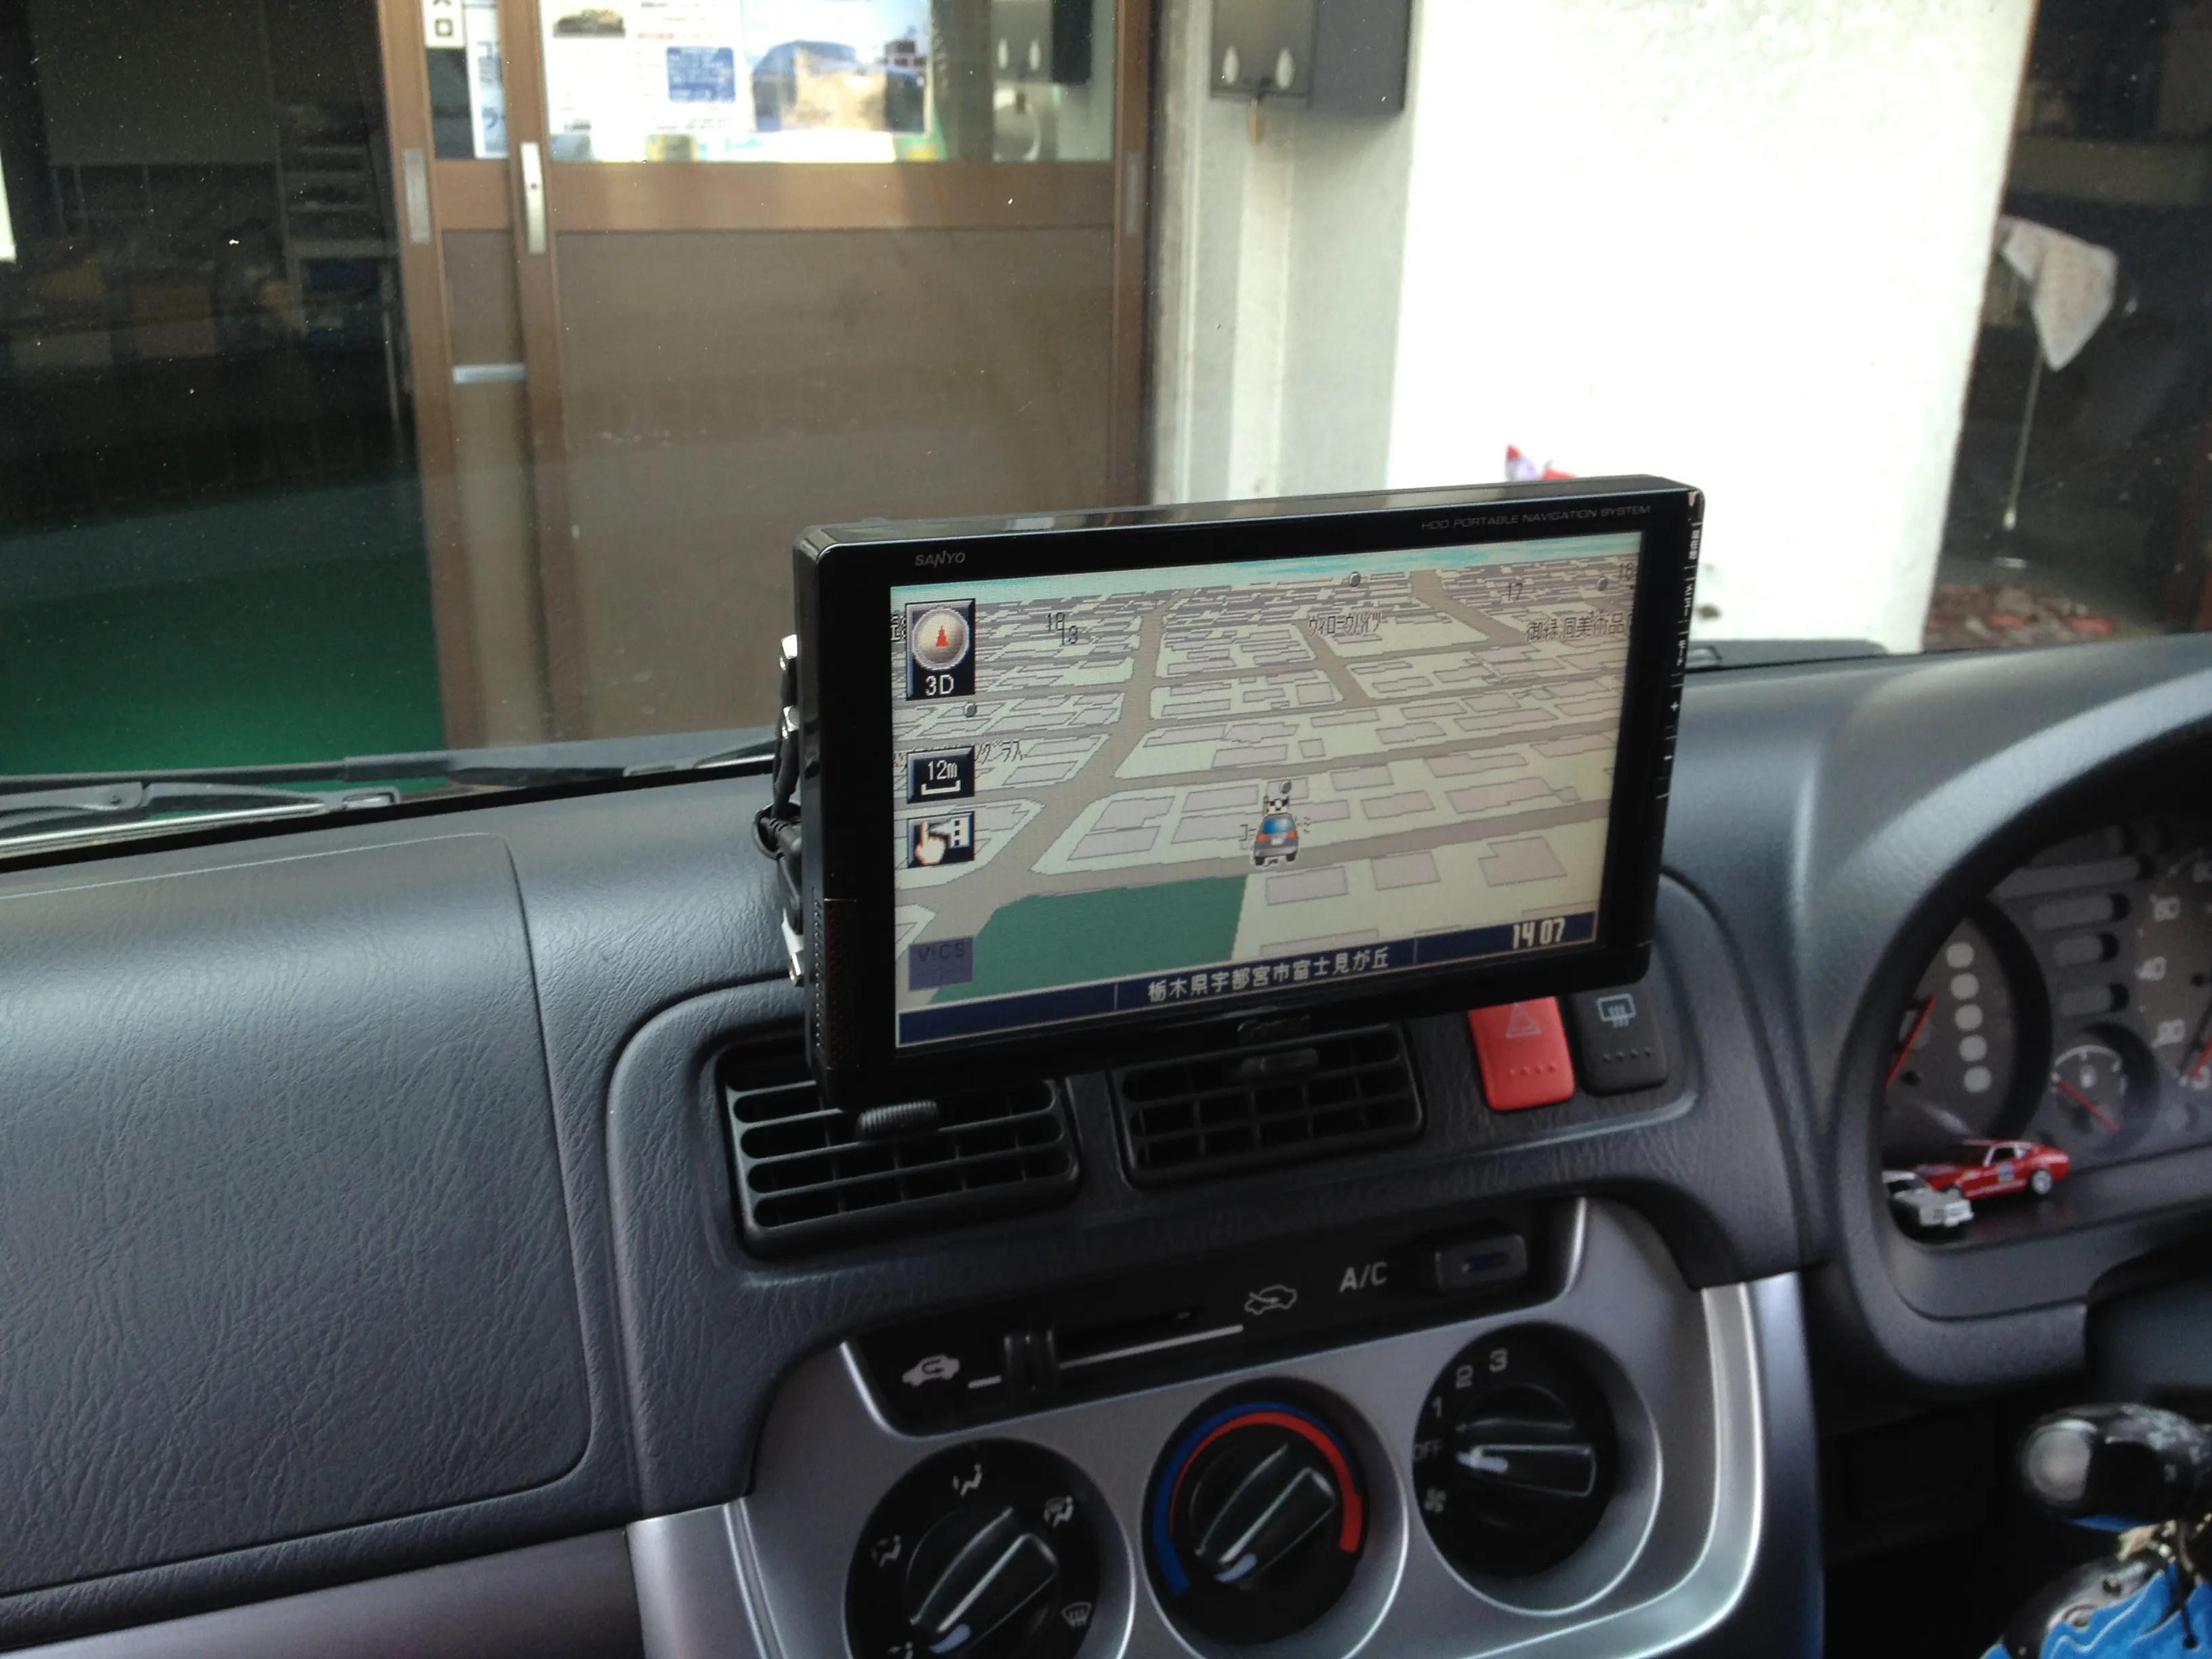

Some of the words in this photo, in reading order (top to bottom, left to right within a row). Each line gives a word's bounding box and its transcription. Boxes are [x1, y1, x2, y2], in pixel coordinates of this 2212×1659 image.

[1454, 515, 1518, 527] PORTABLE
[1522, 508, 1597, 523] NAVIGATION
[1601, 505, 1651, 517] SYSTEM
[915, 550, 966, 568] SANYO
[926, 674, 955, 696] 3D
[927, 759, 958, 781] 12m
[917, 941, 966, 962] VICS
[1339, 1261, 1388, 1293] A/C
[1489, 1347, 1509, 1373] 3
[1455, 1364, 1473, 1389] 2
[1431, 1396, 1443, 1418] 1
